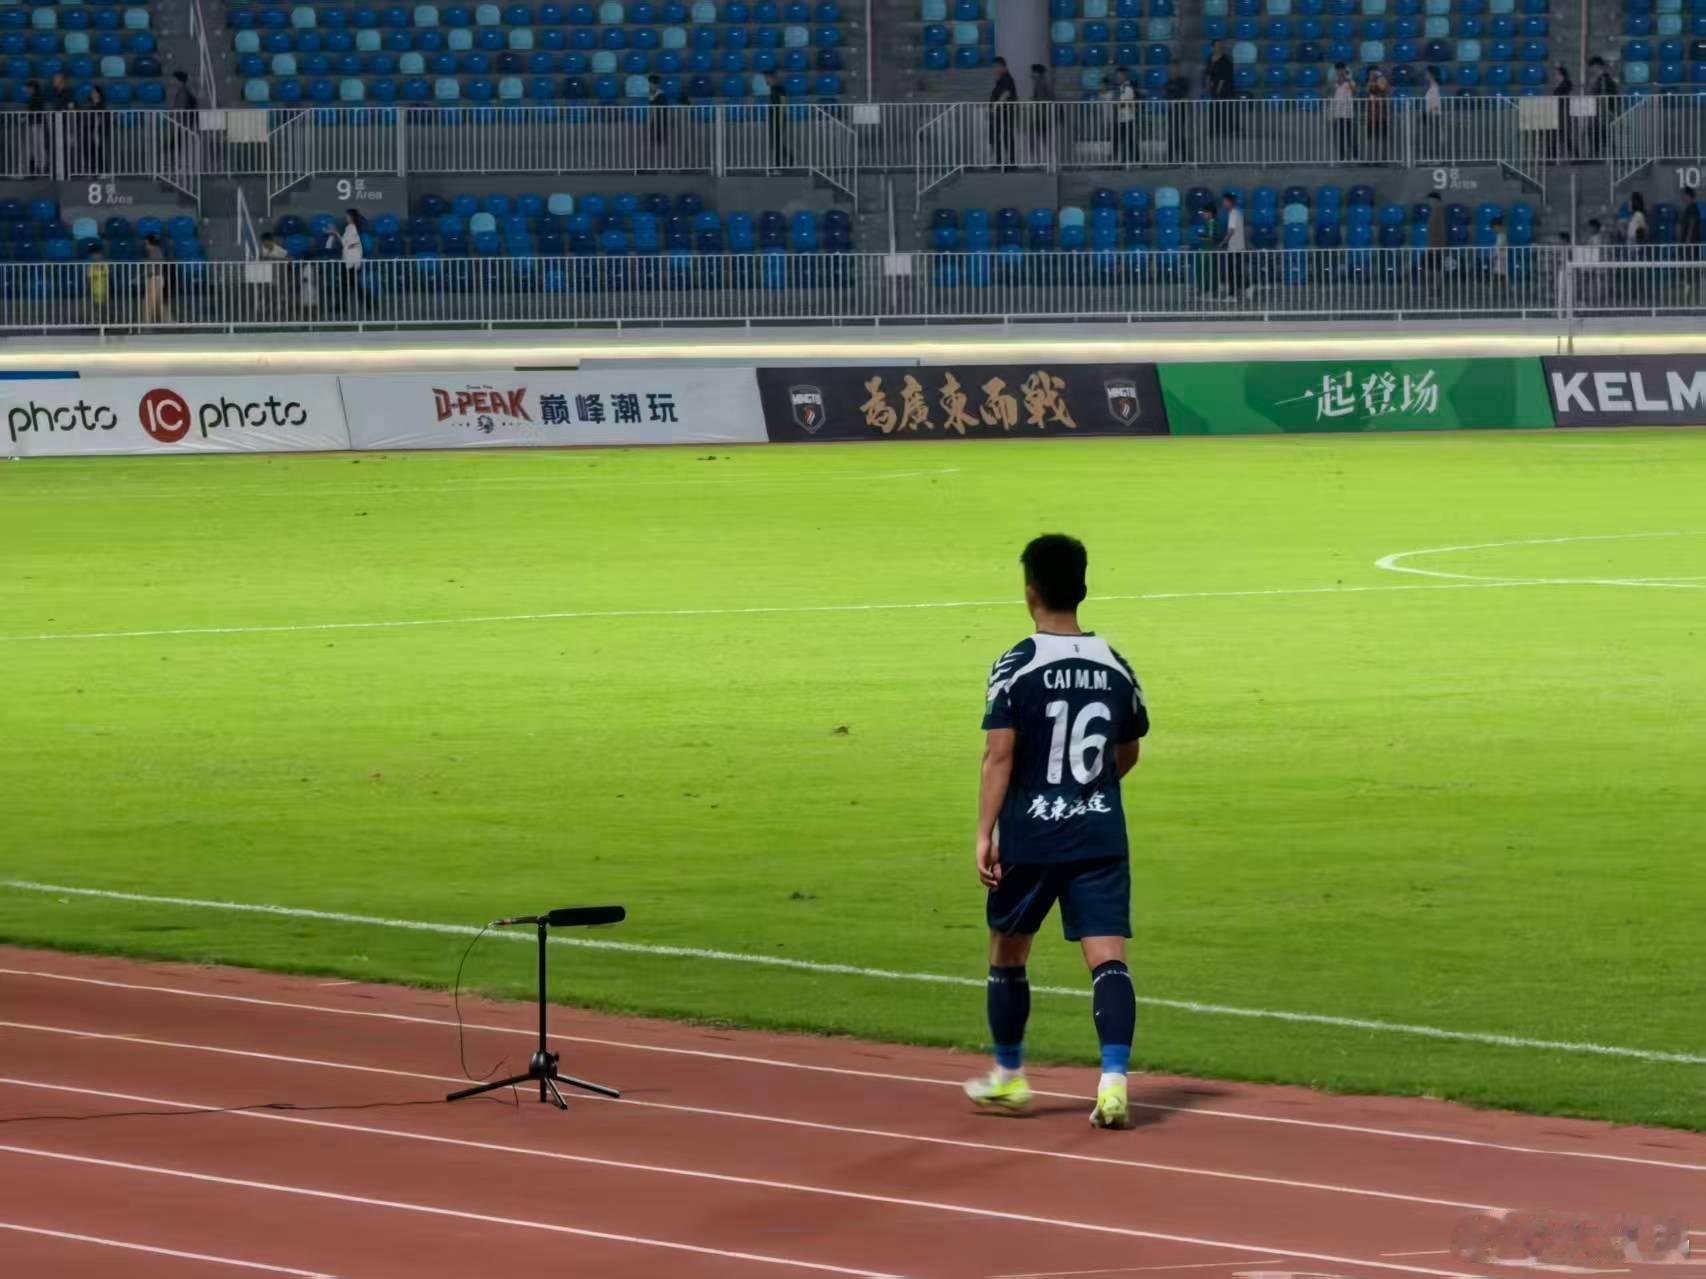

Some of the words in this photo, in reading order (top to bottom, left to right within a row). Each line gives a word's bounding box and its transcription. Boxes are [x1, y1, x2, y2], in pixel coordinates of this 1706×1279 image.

[336, 179, 351, 200] 9
[1433, 168, 1447, 189] 9
[1675, 167, 1700, 188] 10
[88, 184, 102, 204] 8
[432, 387, 534, 422] D-PEAK
[540, 393, 678, 425] 巅峰潮玩
[1274, 369, 1440, 423] 一起登场
[8, 400, 117, 442] photo
[145, 399, 184, 432] IC
[198, 396, 307, 438] photo
[1043, 668, 1071, 690] CAI
[1045, 699, 1112, 785] 16
